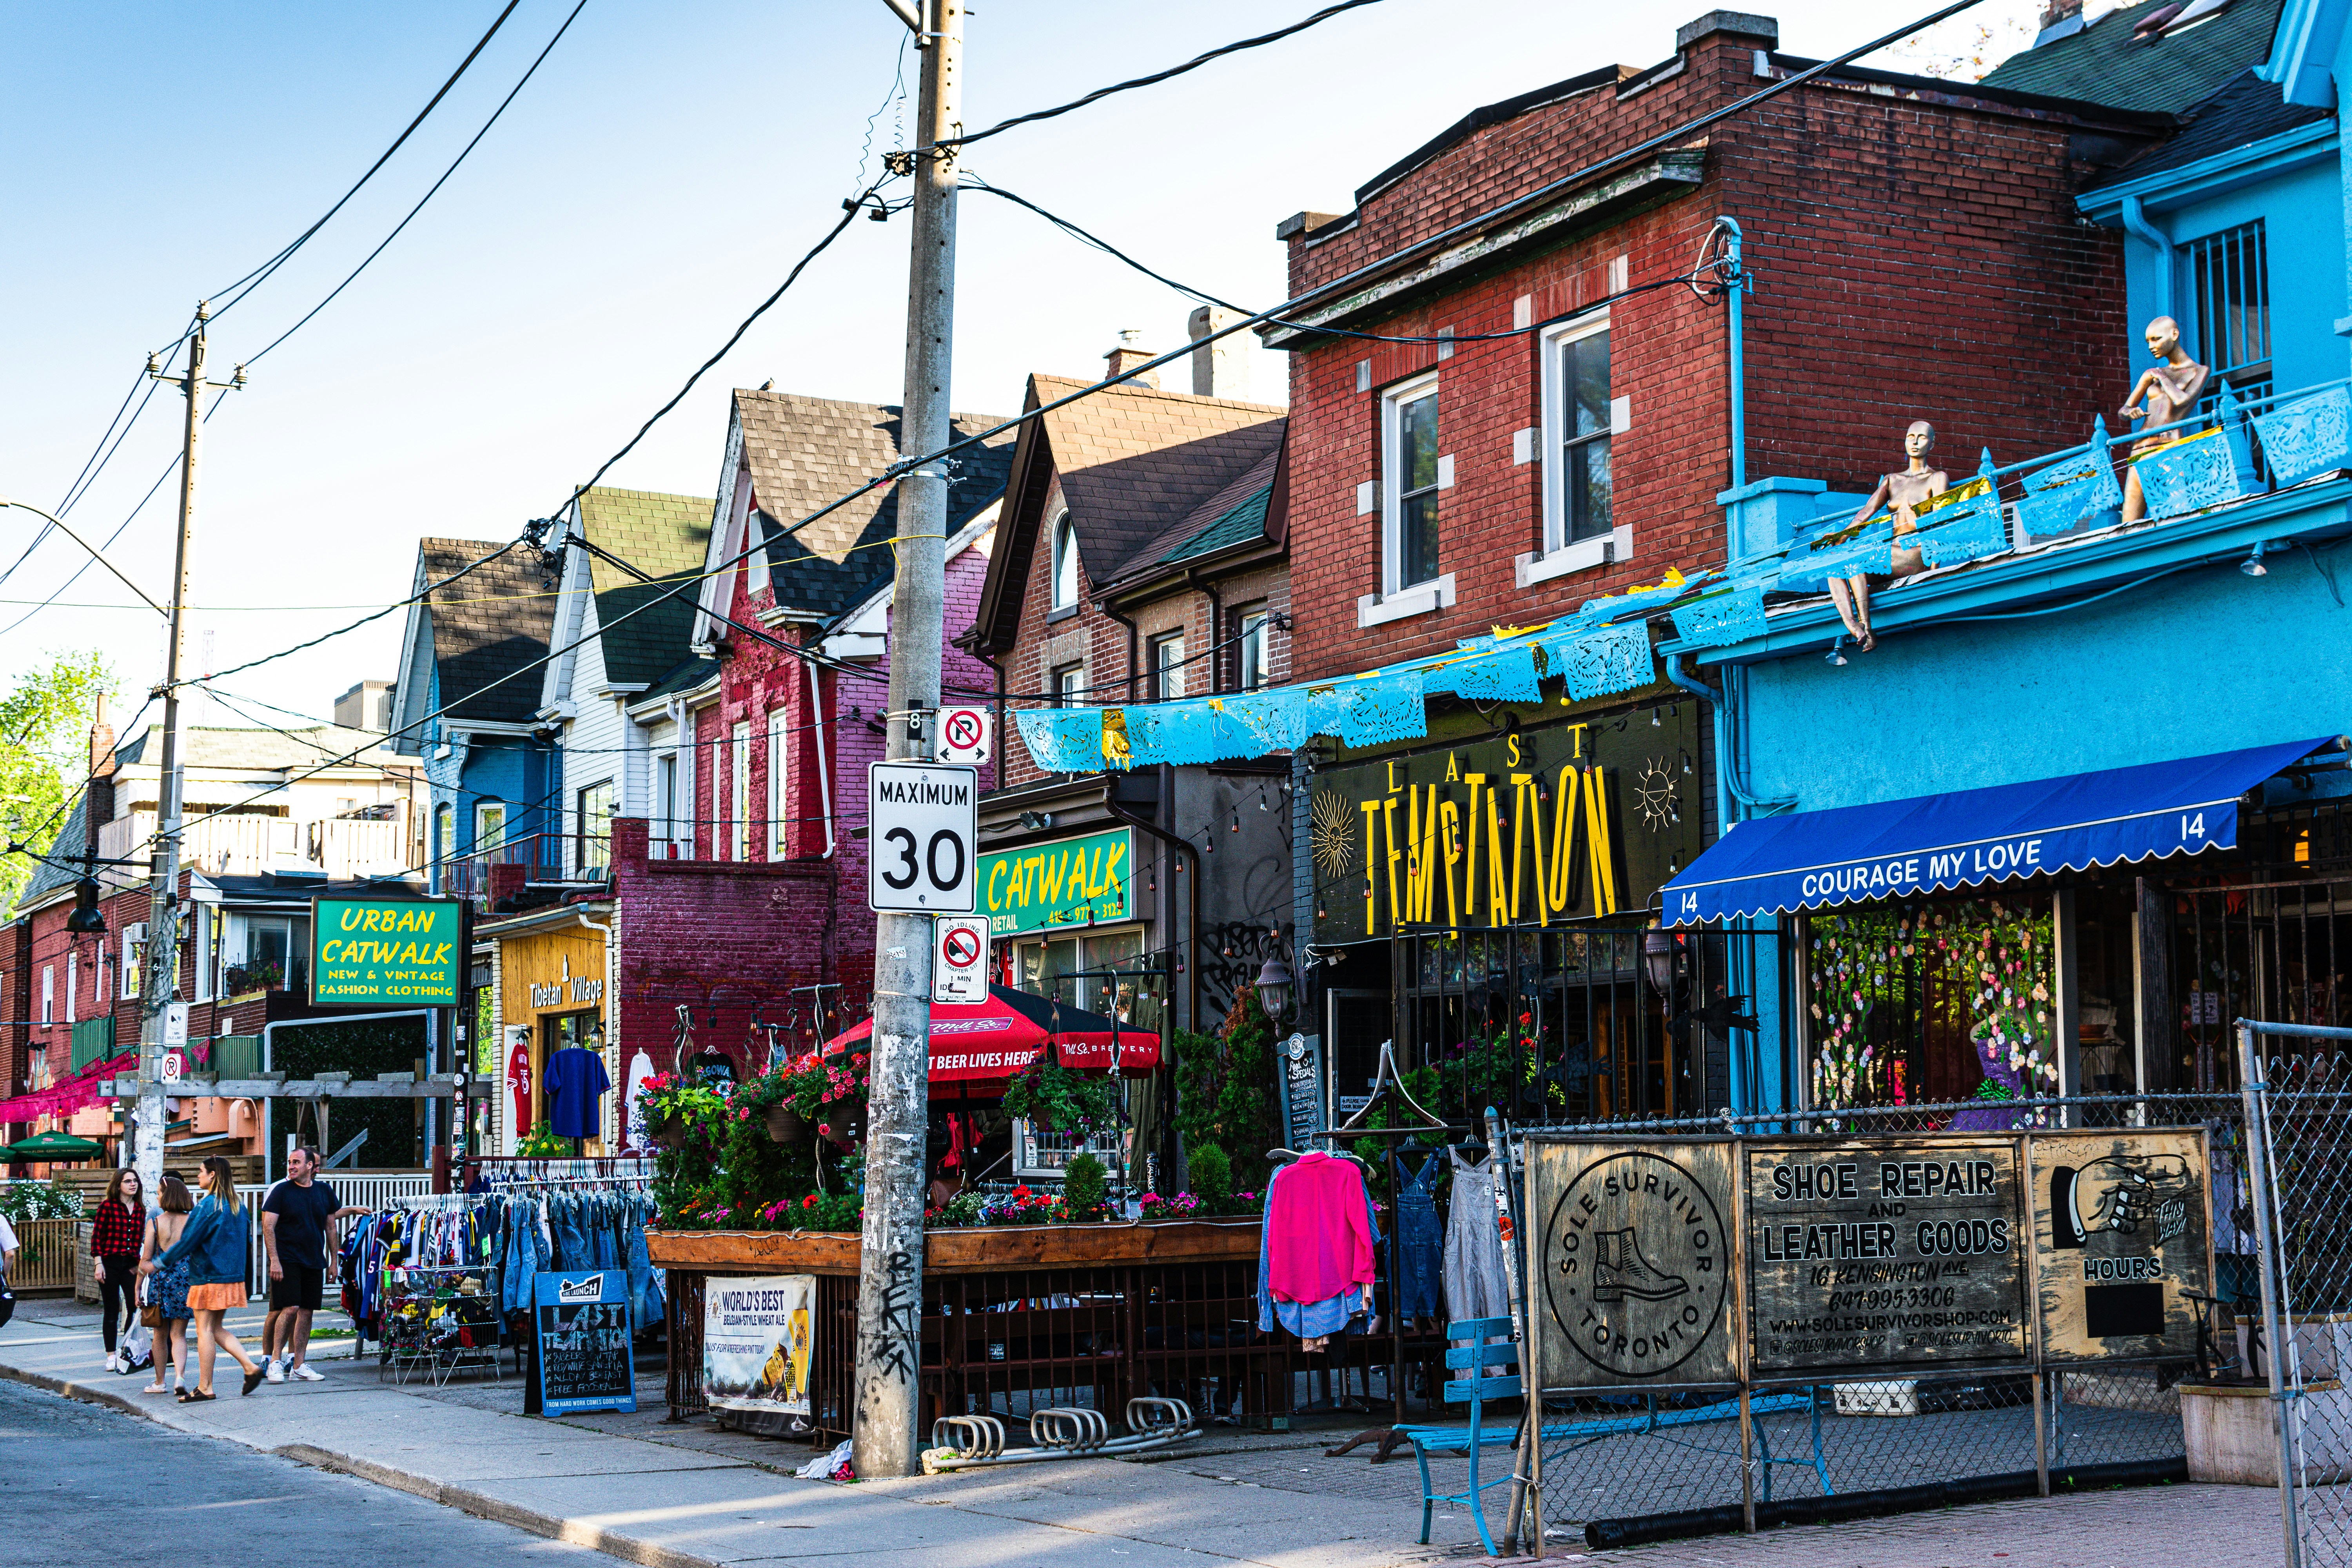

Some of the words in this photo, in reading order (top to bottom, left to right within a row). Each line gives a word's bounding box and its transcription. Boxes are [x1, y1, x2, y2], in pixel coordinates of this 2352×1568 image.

[910, 713, 920, 729] 8
[1387, 723, 1588, 793] LAST
[880, 781, 967, 806] MAXIMUM
[2182, 813, 2205, 840] 14
[882, 827, 965, 891] 30
[1361, 765, 1616, 940] TEMPTATION
[988, 842, 1126, 911] CATWALK
[1802, 858, 1918, 898] COURAGE
[1929, 851, 1966, 879] MY
[1975, 839, 2042, 873] LOVE
[1682, 892, 1698, 913] 14
[341, 908, 436, 933] URBAN
[944, 925, 954, 934] NO
[958, 922, 980, 934] IDLING
[993, 914, 1018, 932] RETAIL
[322, 940, 452, 964] CATWALK
[328, 970, 358, 979] NEW
[367, 970, 376, 979] &
[385, 971, 445, 980] VINTAGE
[945, 963, 968, 973] CHAPTER
[319, 985, 379, 995] FASHION
[386, 985, 453, 996] CLOTHING
[530, 981, 562, 1008] Tibetan
[571, 975, 603, 1007] Village
[929, 1021, 974, 1031] Mill
[936, 1054, 967, 1069] BEER
[969, 1052, 1002, 1068] LIVES
[1077, 1043, 1090, 1055] St.
[1292, 1065, 1316, 1080] SPECIALS
[1772, 1163, 1858, 1201] SHOE
[1880, 1160, 1996, 1199] REPAIR
[1868, 1202, 1906, 1218] AND
[2155, 1199, 2185, 1223] THIS
[1561, 1193, 1598, 1274] SOLE
[1605, 1172, 1712, 1272] SURVIVOR
[2159, 1217, 2187, 1241] WAY!
[1763, 1222, 1897, 1262] LEATHER
[1916, 1218, 2009, 1256] GOODS
[368, 1261, 376, 1273] 5
[1810, 1265, 1831, 1287] 16
[1834, 1260, 1940, 1286] KENSINGTON
[1942, 1260, 1970, 1274] AVE.
[2083, 1257, 2162, 1281] HOURS
[571, 1283, 597, 1296] LAUNCH
[722, 1290, 760, 1312] WORLD'S
[761, 1290, 784, 1311] BEST
[553, 1304, 625, 1333] LAST
[723, 1314, 757, 1326] BELGIAN-STYLE
[757, 1315, 775, 1326] WHEAT
[775, 1314, 785, 1326] ALE
[1580, 1305, 1699, 1358] TORONTO
[1783, 1334, 1886, 1354] @SOLESURVIVORSHOP
[1917, 1328, 2013, 1348] @SOLESURVIVORTO
[560, 1352, 586, 1361] BEERS
[602, 1350, 619, 1362] TAP
[717, 1343, 727, 1353] FOR
[554, 1385, 573, 1395] FREE
